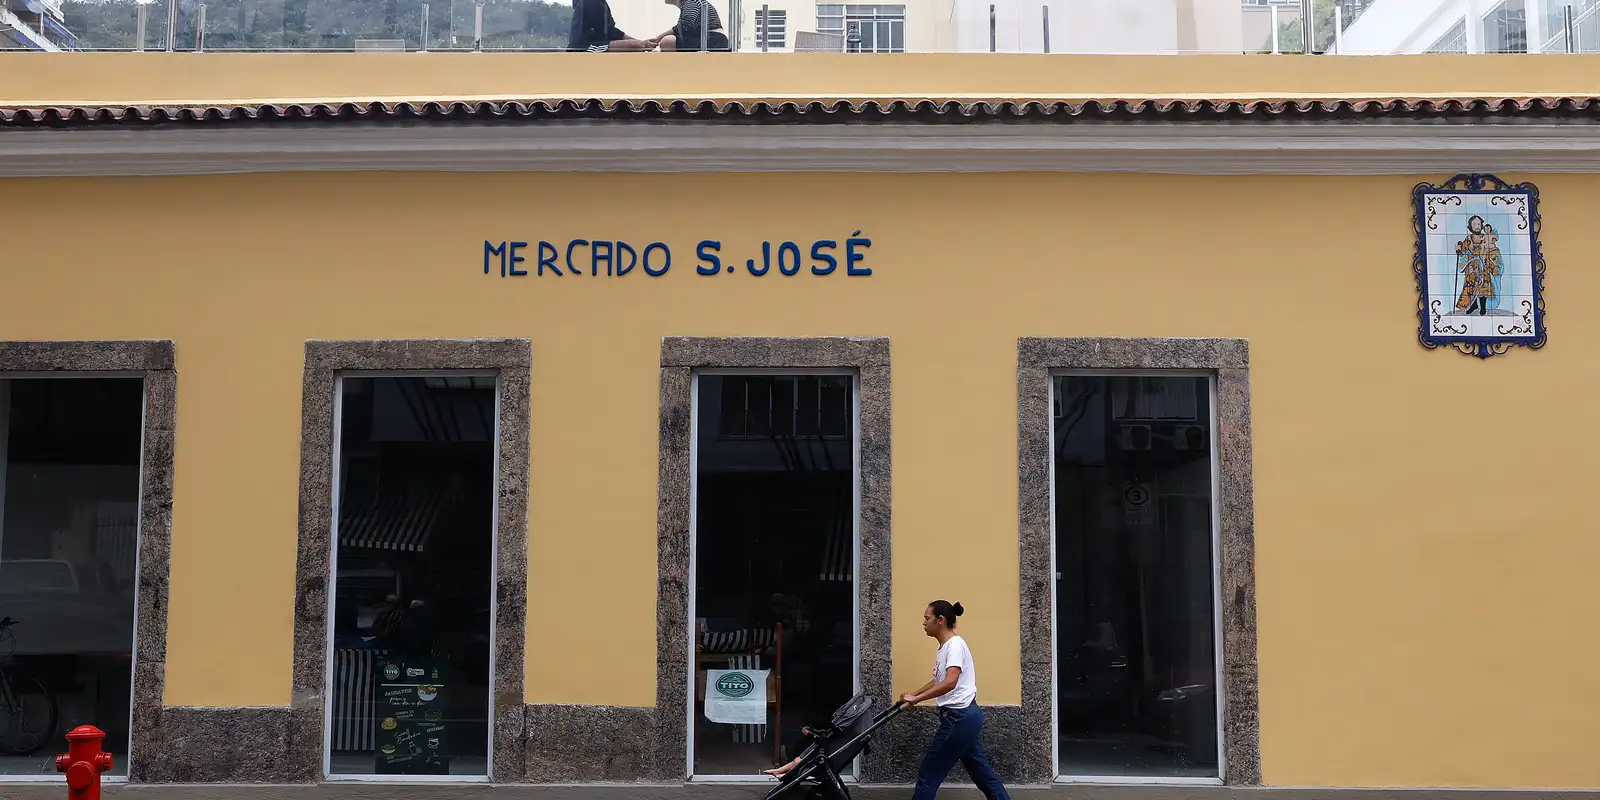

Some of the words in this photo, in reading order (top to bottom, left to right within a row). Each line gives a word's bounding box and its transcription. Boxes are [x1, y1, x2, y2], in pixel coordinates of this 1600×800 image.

[484, 239, 671, 277] MERCADO
[696, 240, 735, 276] S.
[746, 229, 873, 277] JOSÉ
